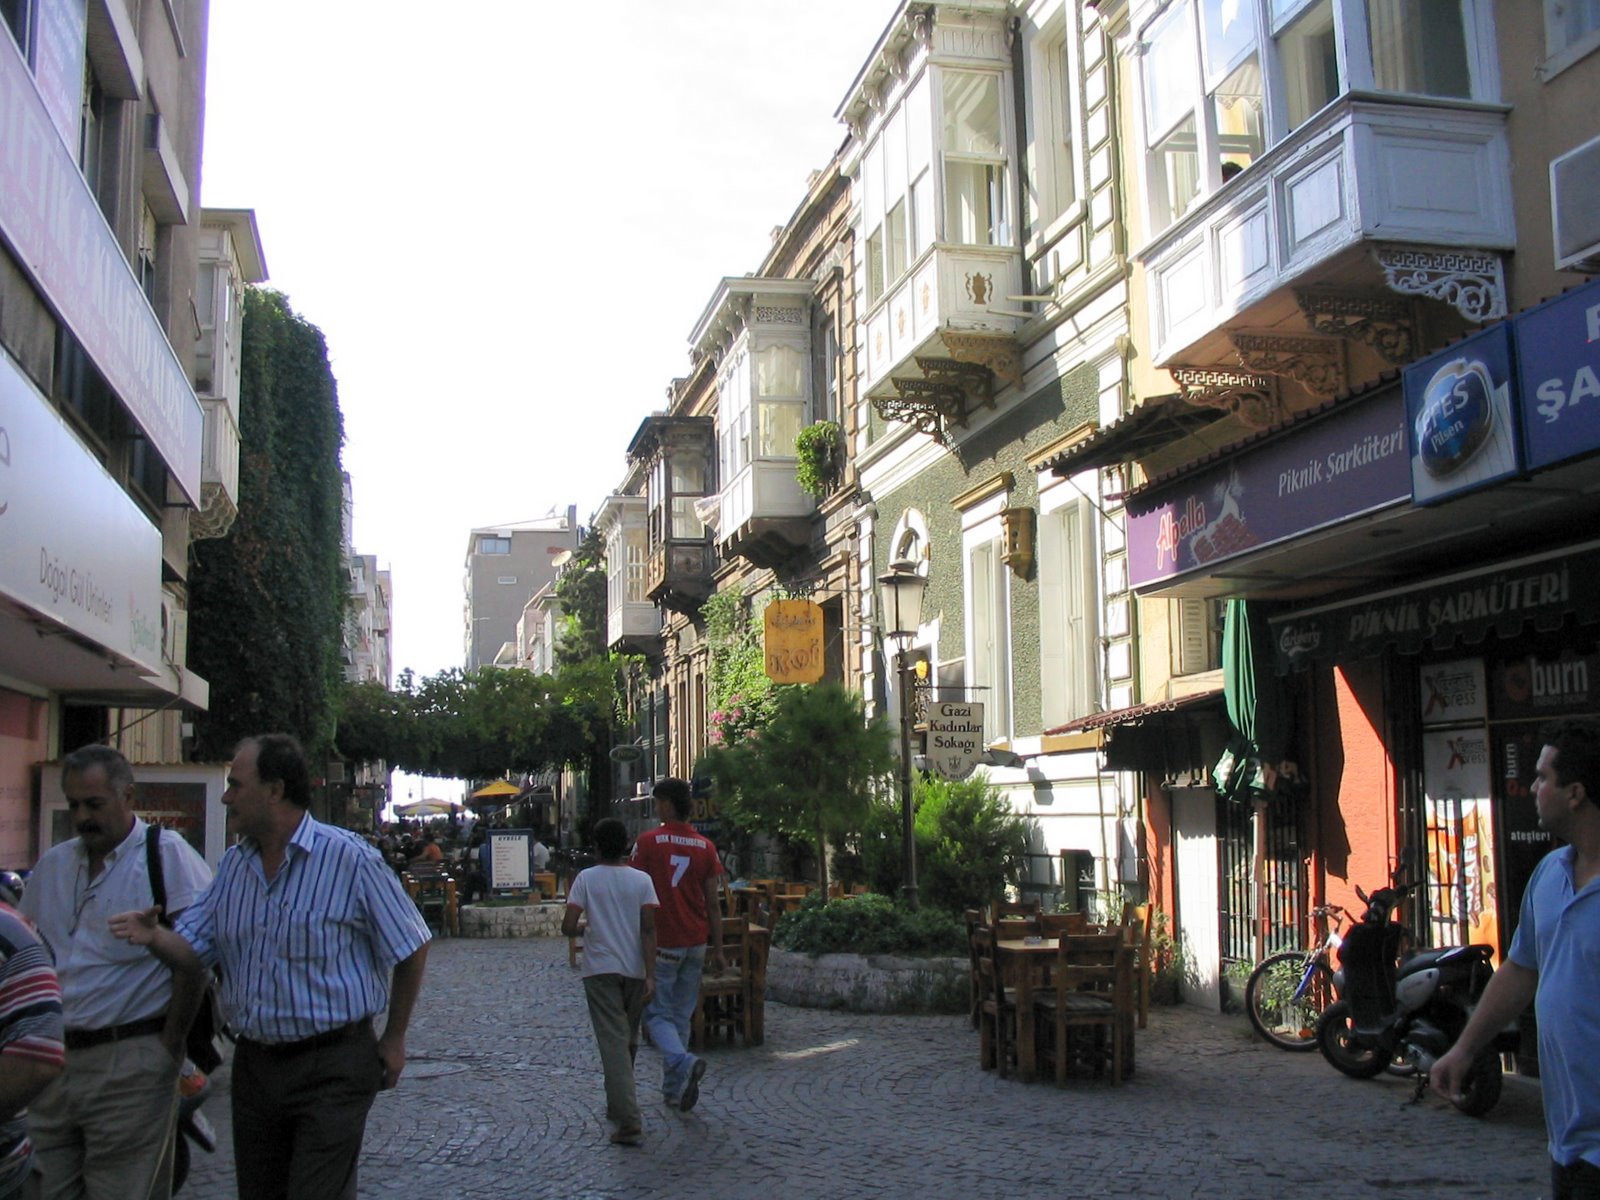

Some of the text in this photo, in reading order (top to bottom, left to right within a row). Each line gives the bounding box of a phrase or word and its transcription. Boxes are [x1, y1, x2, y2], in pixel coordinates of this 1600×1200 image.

[1430, 419, 1465, 453] Pilsen
[1278, 423, 1404, 497] Piknik Şarküteri
[1156, 495, 1207, 570] Alpella
[1350, 560, 1570, 641] PİKNİK ŞARKÜTERİ
[1280, 622, 1321, 657] Carlsberg
[1530, 657, 1589, 697] burn
[929, 719, 982, 733] Kadınlar
[941, 703, 971, 717] Gazi
[934, 735, 975, 755] Sokağı
[1506, 743, 1519, 778] burn
[1511, 831, 1551, 843] ateşler!
[669, 854, 691, 889] 7
